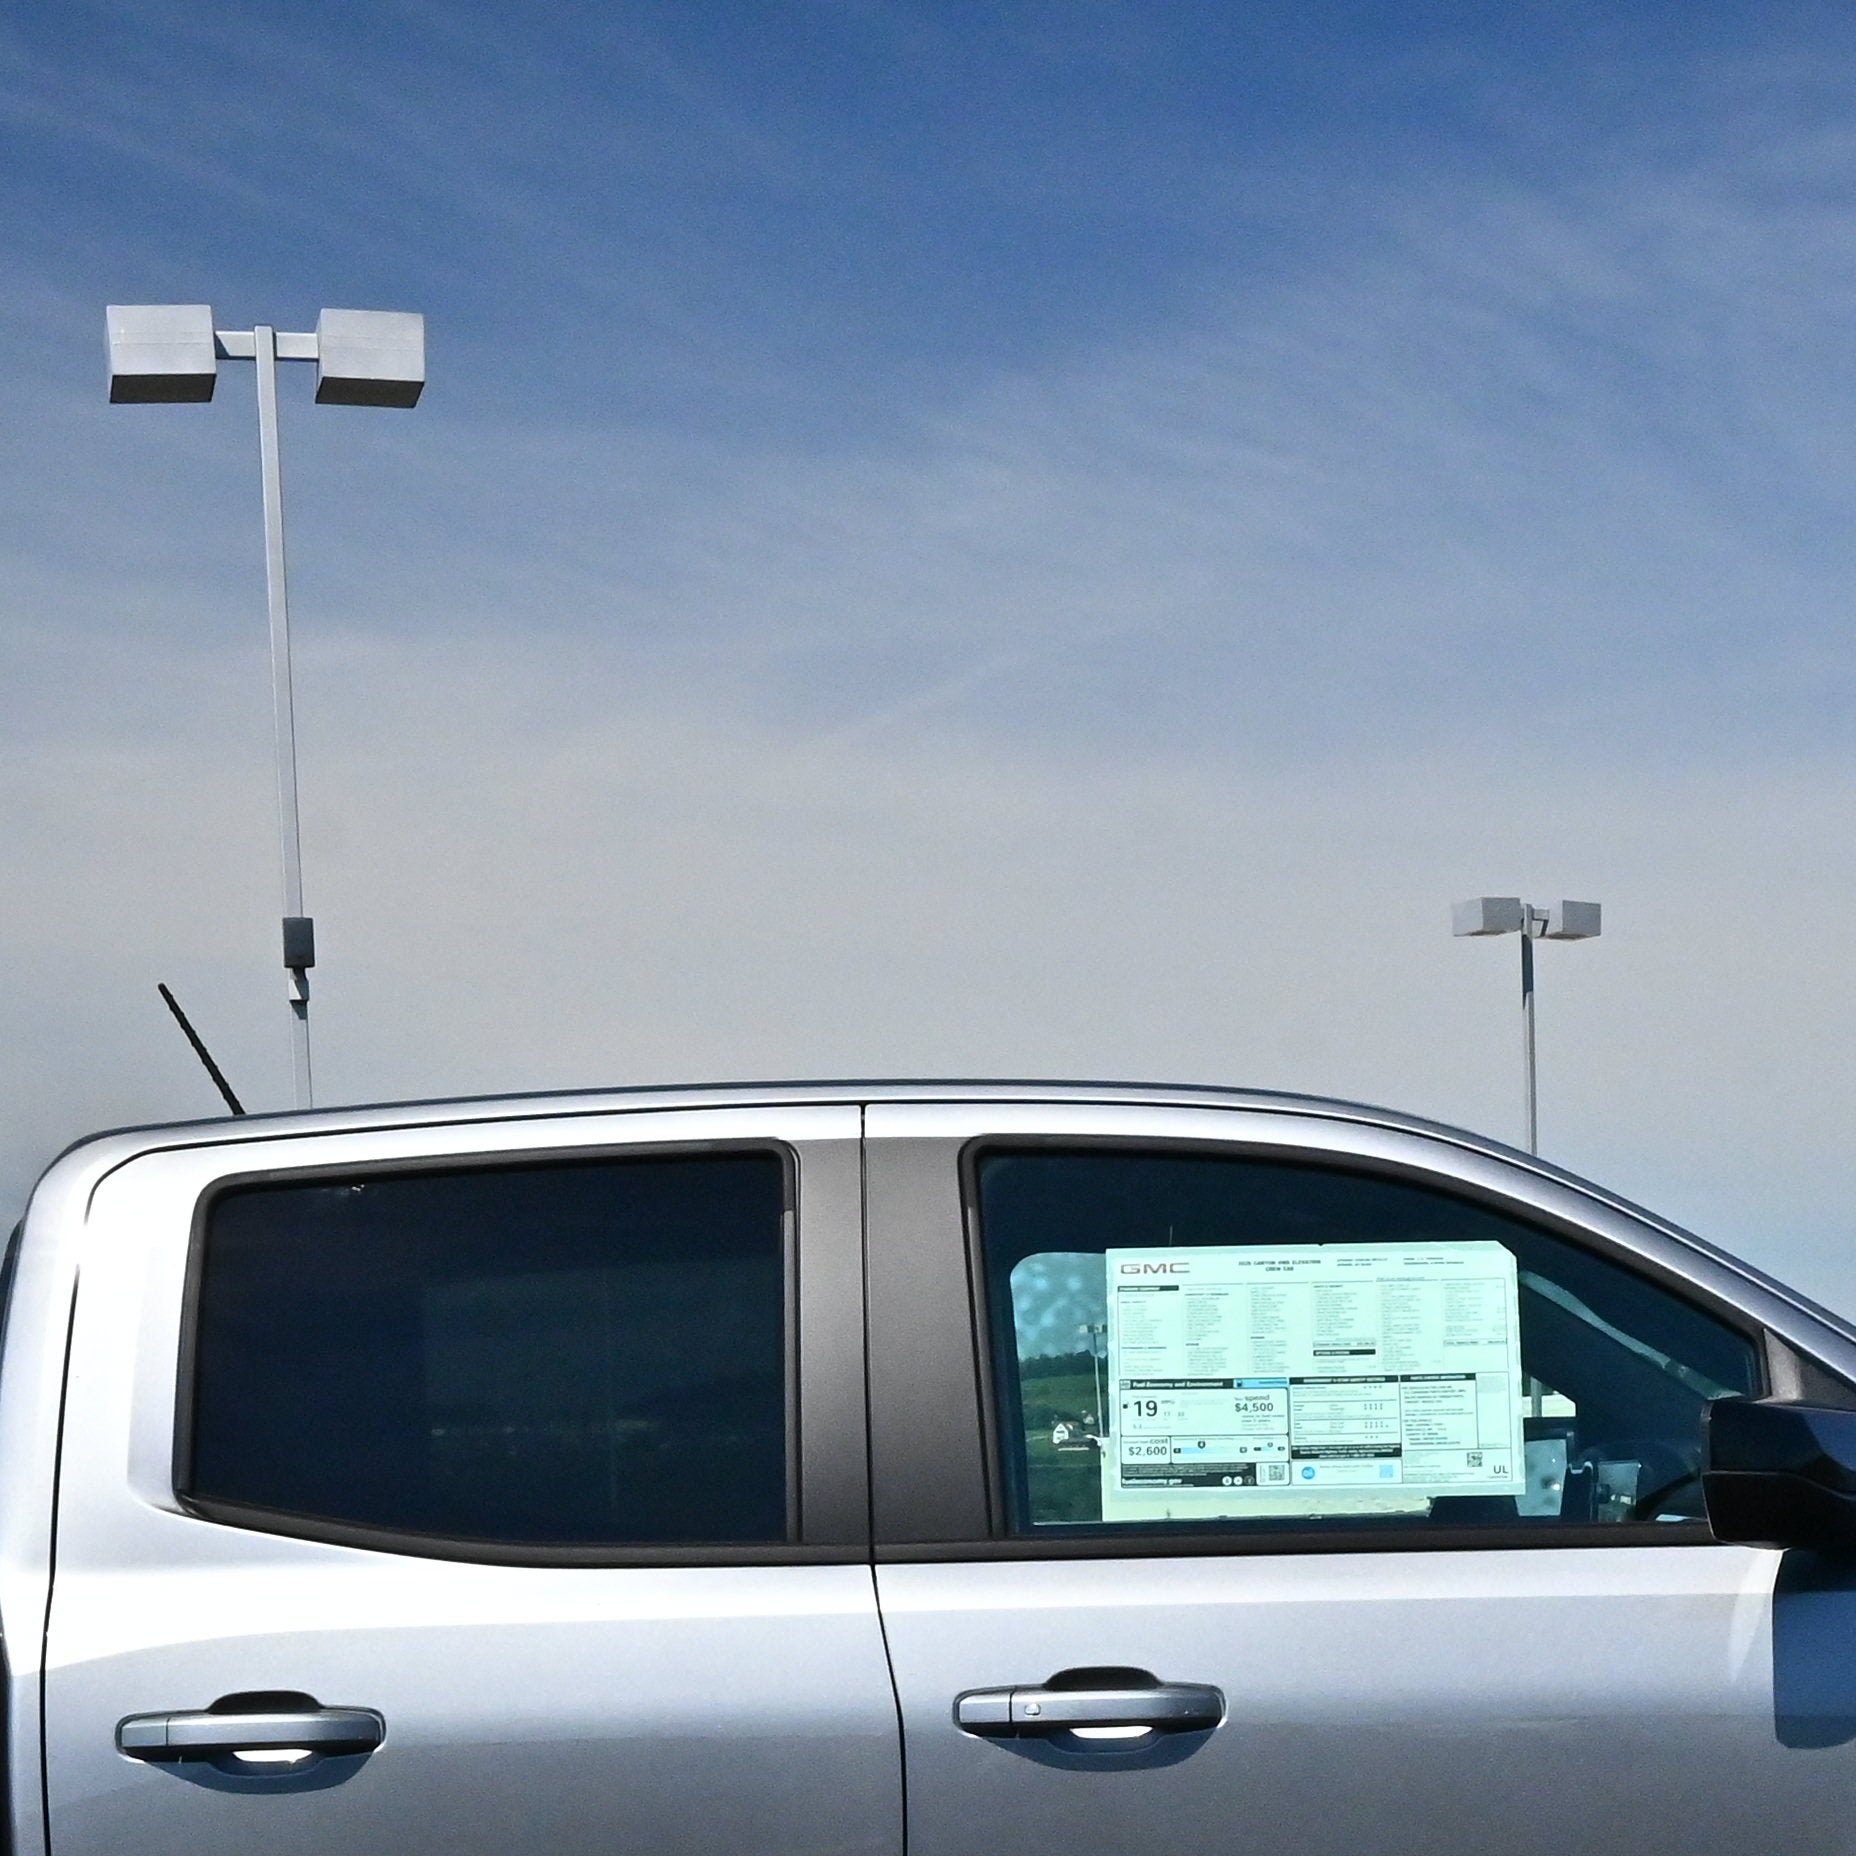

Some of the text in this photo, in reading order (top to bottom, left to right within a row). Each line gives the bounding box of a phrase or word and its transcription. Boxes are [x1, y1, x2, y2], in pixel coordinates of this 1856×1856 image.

[1120, 1262, 1190, 1275] GMC
[1133, 1399, 1158, 1418] 19
[1234, 1402, 1274, 1413] $4,500
[1128, 1446, 1168, 1457] $2,600
[1493, 1465, 1509, 1474] UL
